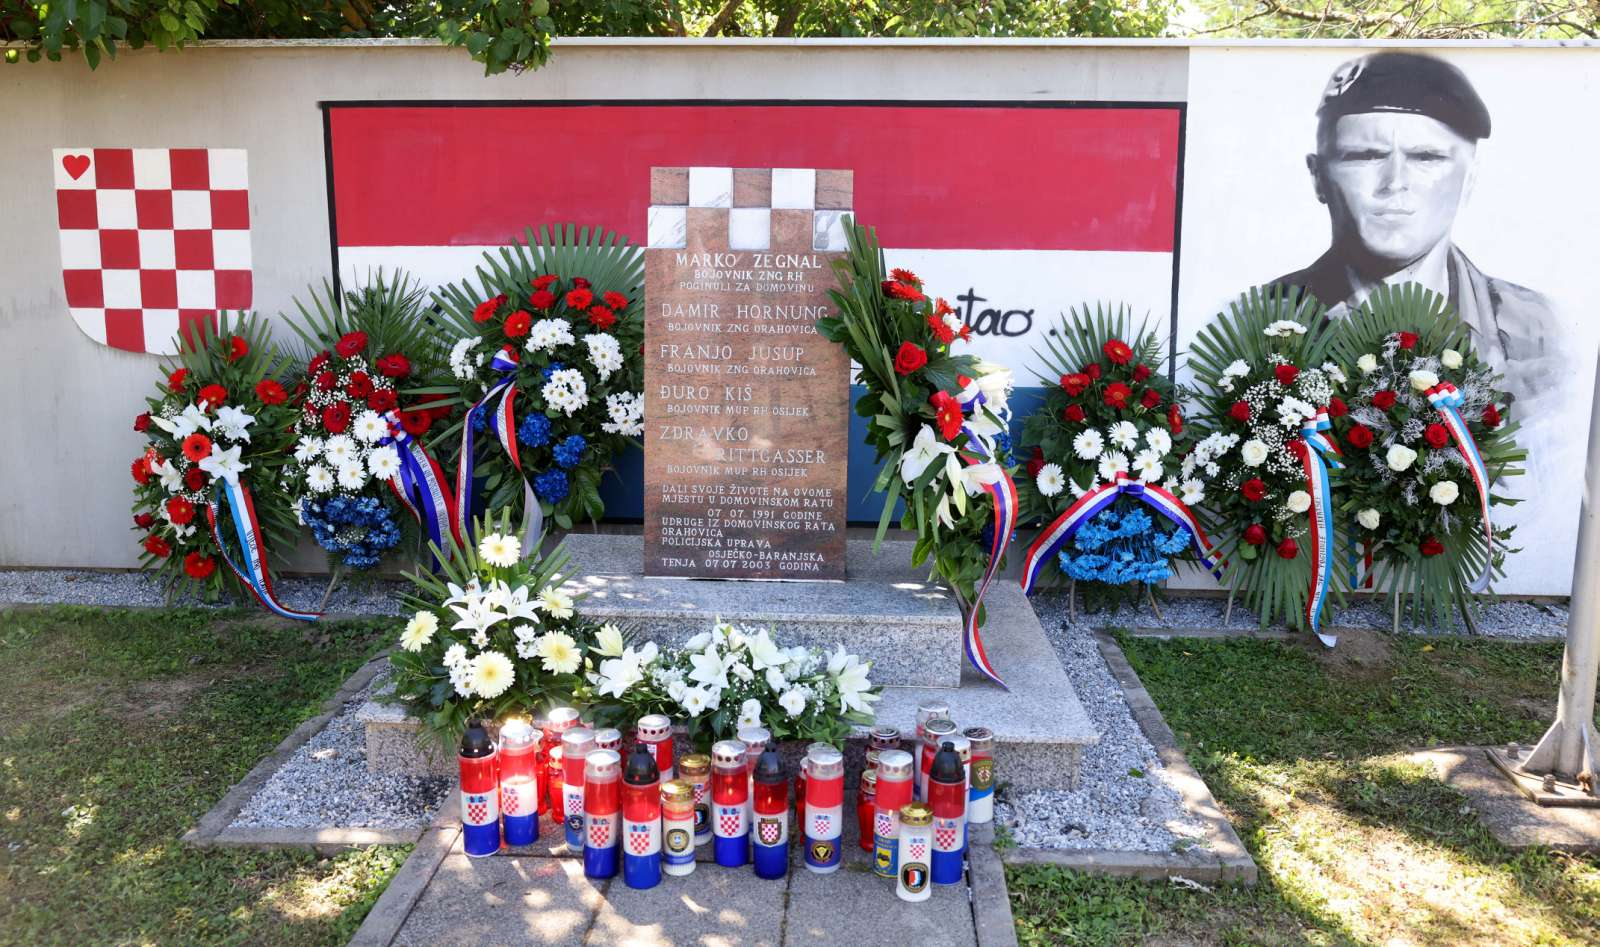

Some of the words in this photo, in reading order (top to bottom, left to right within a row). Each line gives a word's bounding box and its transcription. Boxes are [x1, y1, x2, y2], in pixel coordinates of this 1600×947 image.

[676, 253, 737, 268] MARKO
[753, 254, 822, 269] ZEGNAL
[694, 270, 753, 280] BOJOVNIK
[759, 271, 783, 280] ZNG
[787, 272, 803, 281] RH
[679, 282, 731, 292] POGINULI
[735, 283, 750, 291] ZA
[756, 283, 814, 293] DOMOVINU
[662, 304, 720, 318] DAMIR
[737, 305, 829, 320] HORNUNG
[668, 324, 721, 333] BOJOVNIK
[727, 325, 749, 333] ZNG
[754, 325, 818, 335] ORAHOVICA
[660, 345, 732, 359] FRANJO
[748, 346, 805, 361] JUSUP
[667, 365, 721, 374] BOJOVNIK
[726, 365, 749, 374] ZNG
[753, 367, 817, 376] ORAHOVICA
[660, 386, 709, 400] ĐURO
[725, 385, 753, 401] KIŠ
[667, 405, 720, 414] BOJOVNIK
[726, 405, 749, 415] MUP
[753, 407, 768, 415] RH
[772, 407, 809, 416] OSIJEK
[659, 426, 749, 441] ZDRAVKO
[714, 448, 826, 464] RITTGASSER
[667, 465, 720, 475] BOJOVNIK
[725, 466, 748, 475] MUP
[752, 467, 768, 475] RH
[771, 468, 808, 477] OSIJEK
[662, 485, 688, 493] DALI
[692, 486, 725, 494] SVOJE
[729, 484, 769, 495] ŽIVOTE
[773, 487, 788, 496] NA
[794, 488, 832, 497] OVOME
[662, 495, 704, 504] MJESTU
[709, 496, 715, 504] U
[720, 496, 799, 507] DOMOVINSKOM
[804, 499, 833, 507] RATU
[753, 510, 775, 519] 1991
[783, 511, 823, 520] GODINE
[662, 518, 704, 527] UDRUGE
[708, 519, 719, 527] IZ
[724, 520, 800, 529] DOMOVINSKOG
[805, 522, 835, 531] RATA
[662, 527, 723, 537] ORAHOVICA
[662, 537, 721, 547] POLICIJSKA
[727, 540, 771, 548] UPRAVA
[708, 548, 824, 561] OSJEČKO-BARANJSKA
[662, 558, 696, 567] TENJA
[742, 561, 771, 569] 2003
[780, 562, 820, 571] GODINA
